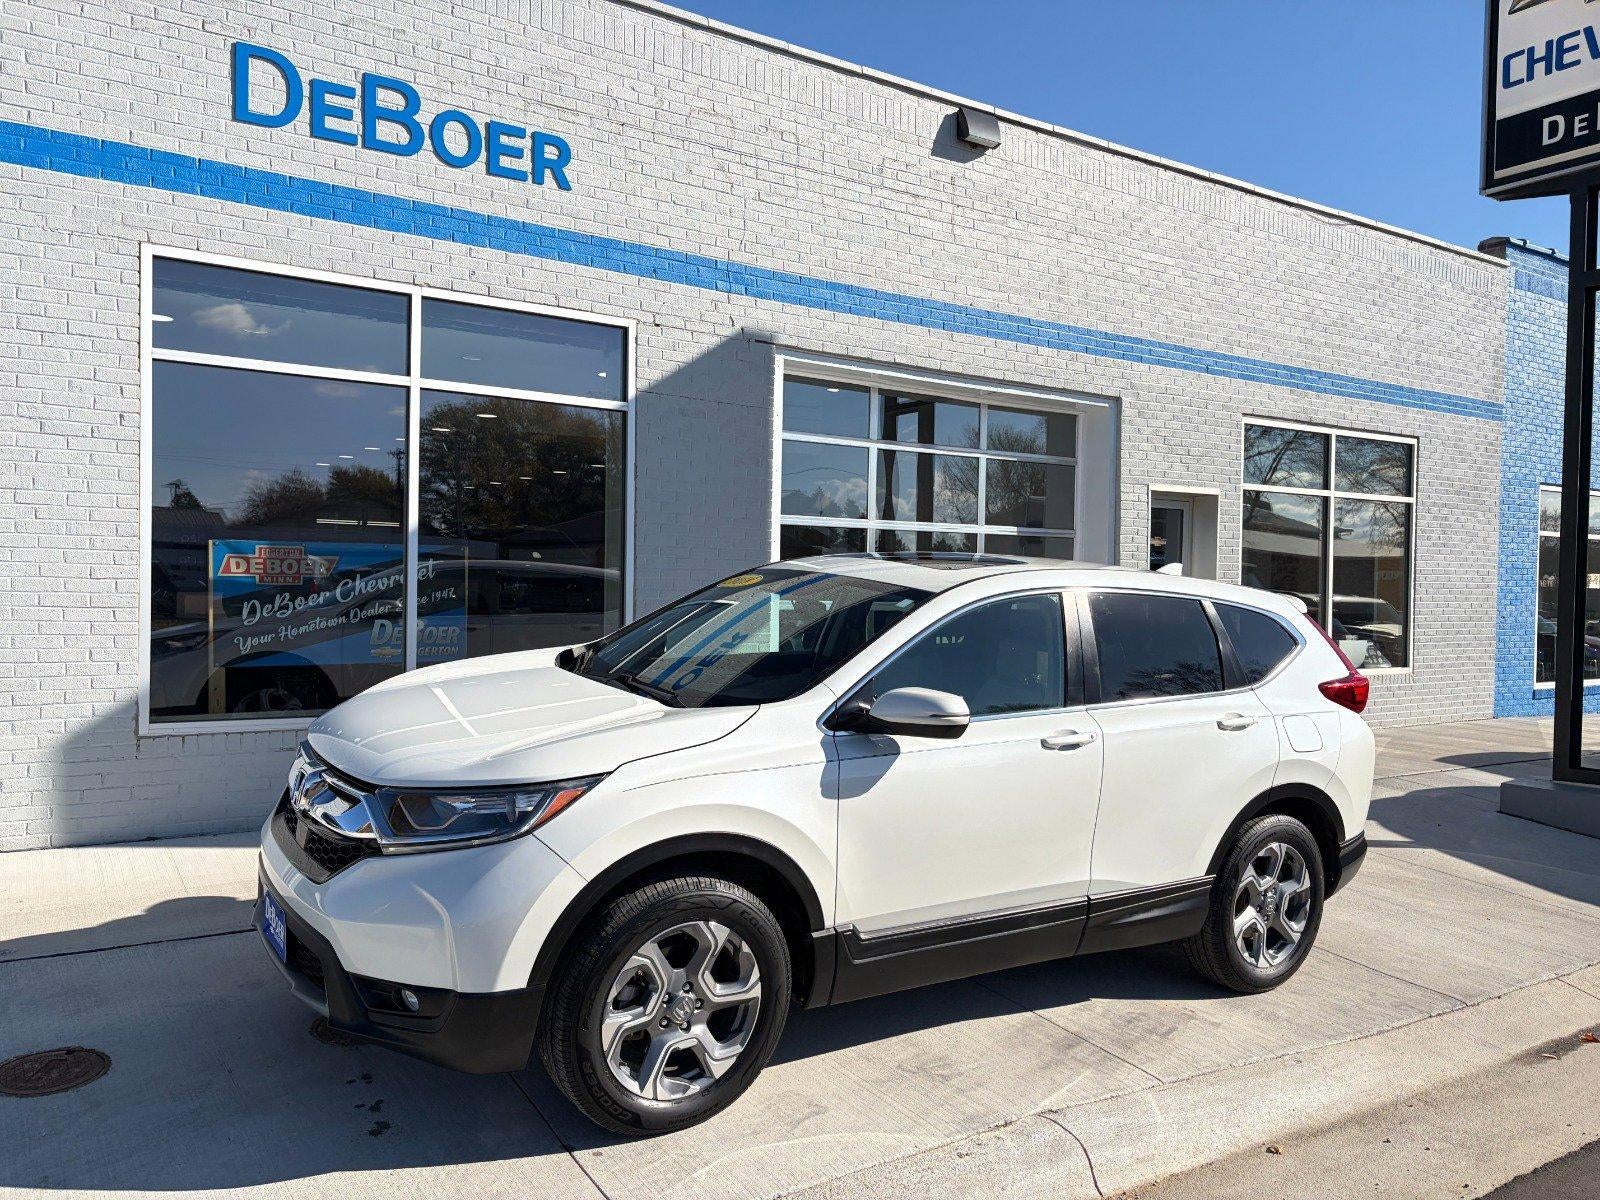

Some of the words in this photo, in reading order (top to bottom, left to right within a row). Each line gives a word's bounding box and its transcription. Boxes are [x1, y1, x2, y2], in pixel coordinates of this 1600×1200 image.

[1542, 102, 1600, 146] DE
[261, 548, 300, 558] EDGERTON
[242, 591, 330, 626] DeBoer
[335, 559, 440, 603] Chevret
[234, 633, 275, 655] Your
[279, 616, 347, 641] Hometown
[350, 602, 391, 624] Dealer
